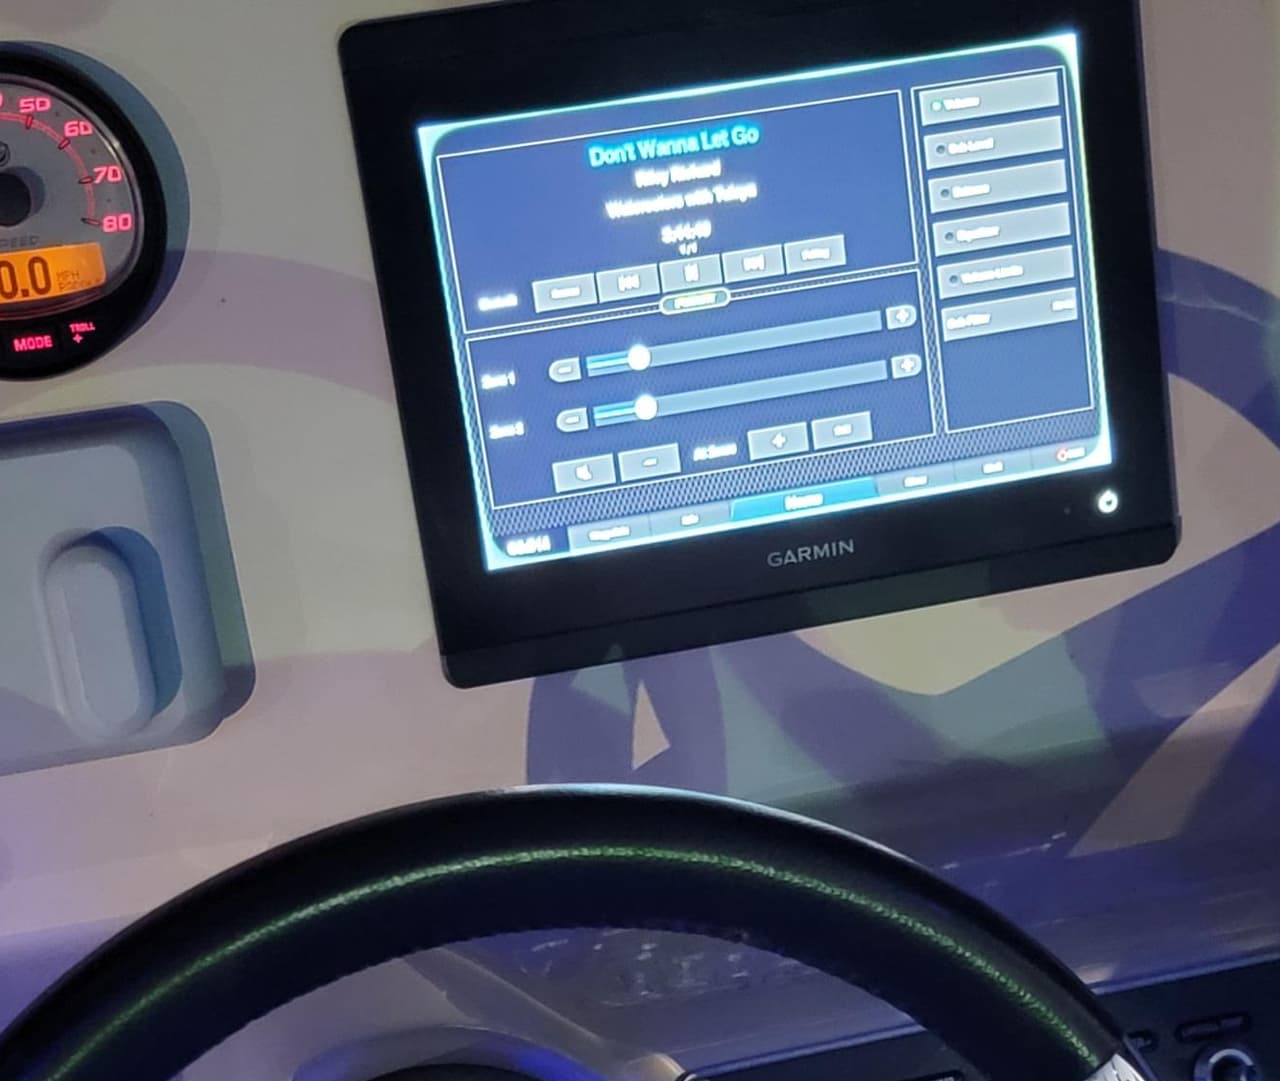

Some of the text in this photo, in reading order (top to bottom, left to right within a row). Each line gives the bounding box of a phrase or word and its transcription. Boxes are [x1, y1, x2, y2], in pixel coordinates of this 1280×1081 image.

[20, 97, 51, 112] 50
[64, 121, 93, 136] 60
[588, 124, 760, 167] Don't Wanna Let Go
[93, 166, 122, 184] 70
[103, 214, 132, 232] 80
[70, 322, 95, 332] TROLL
[13, 335, 53, 352] MODE
[767, 538, 854, 567] GARMIN
